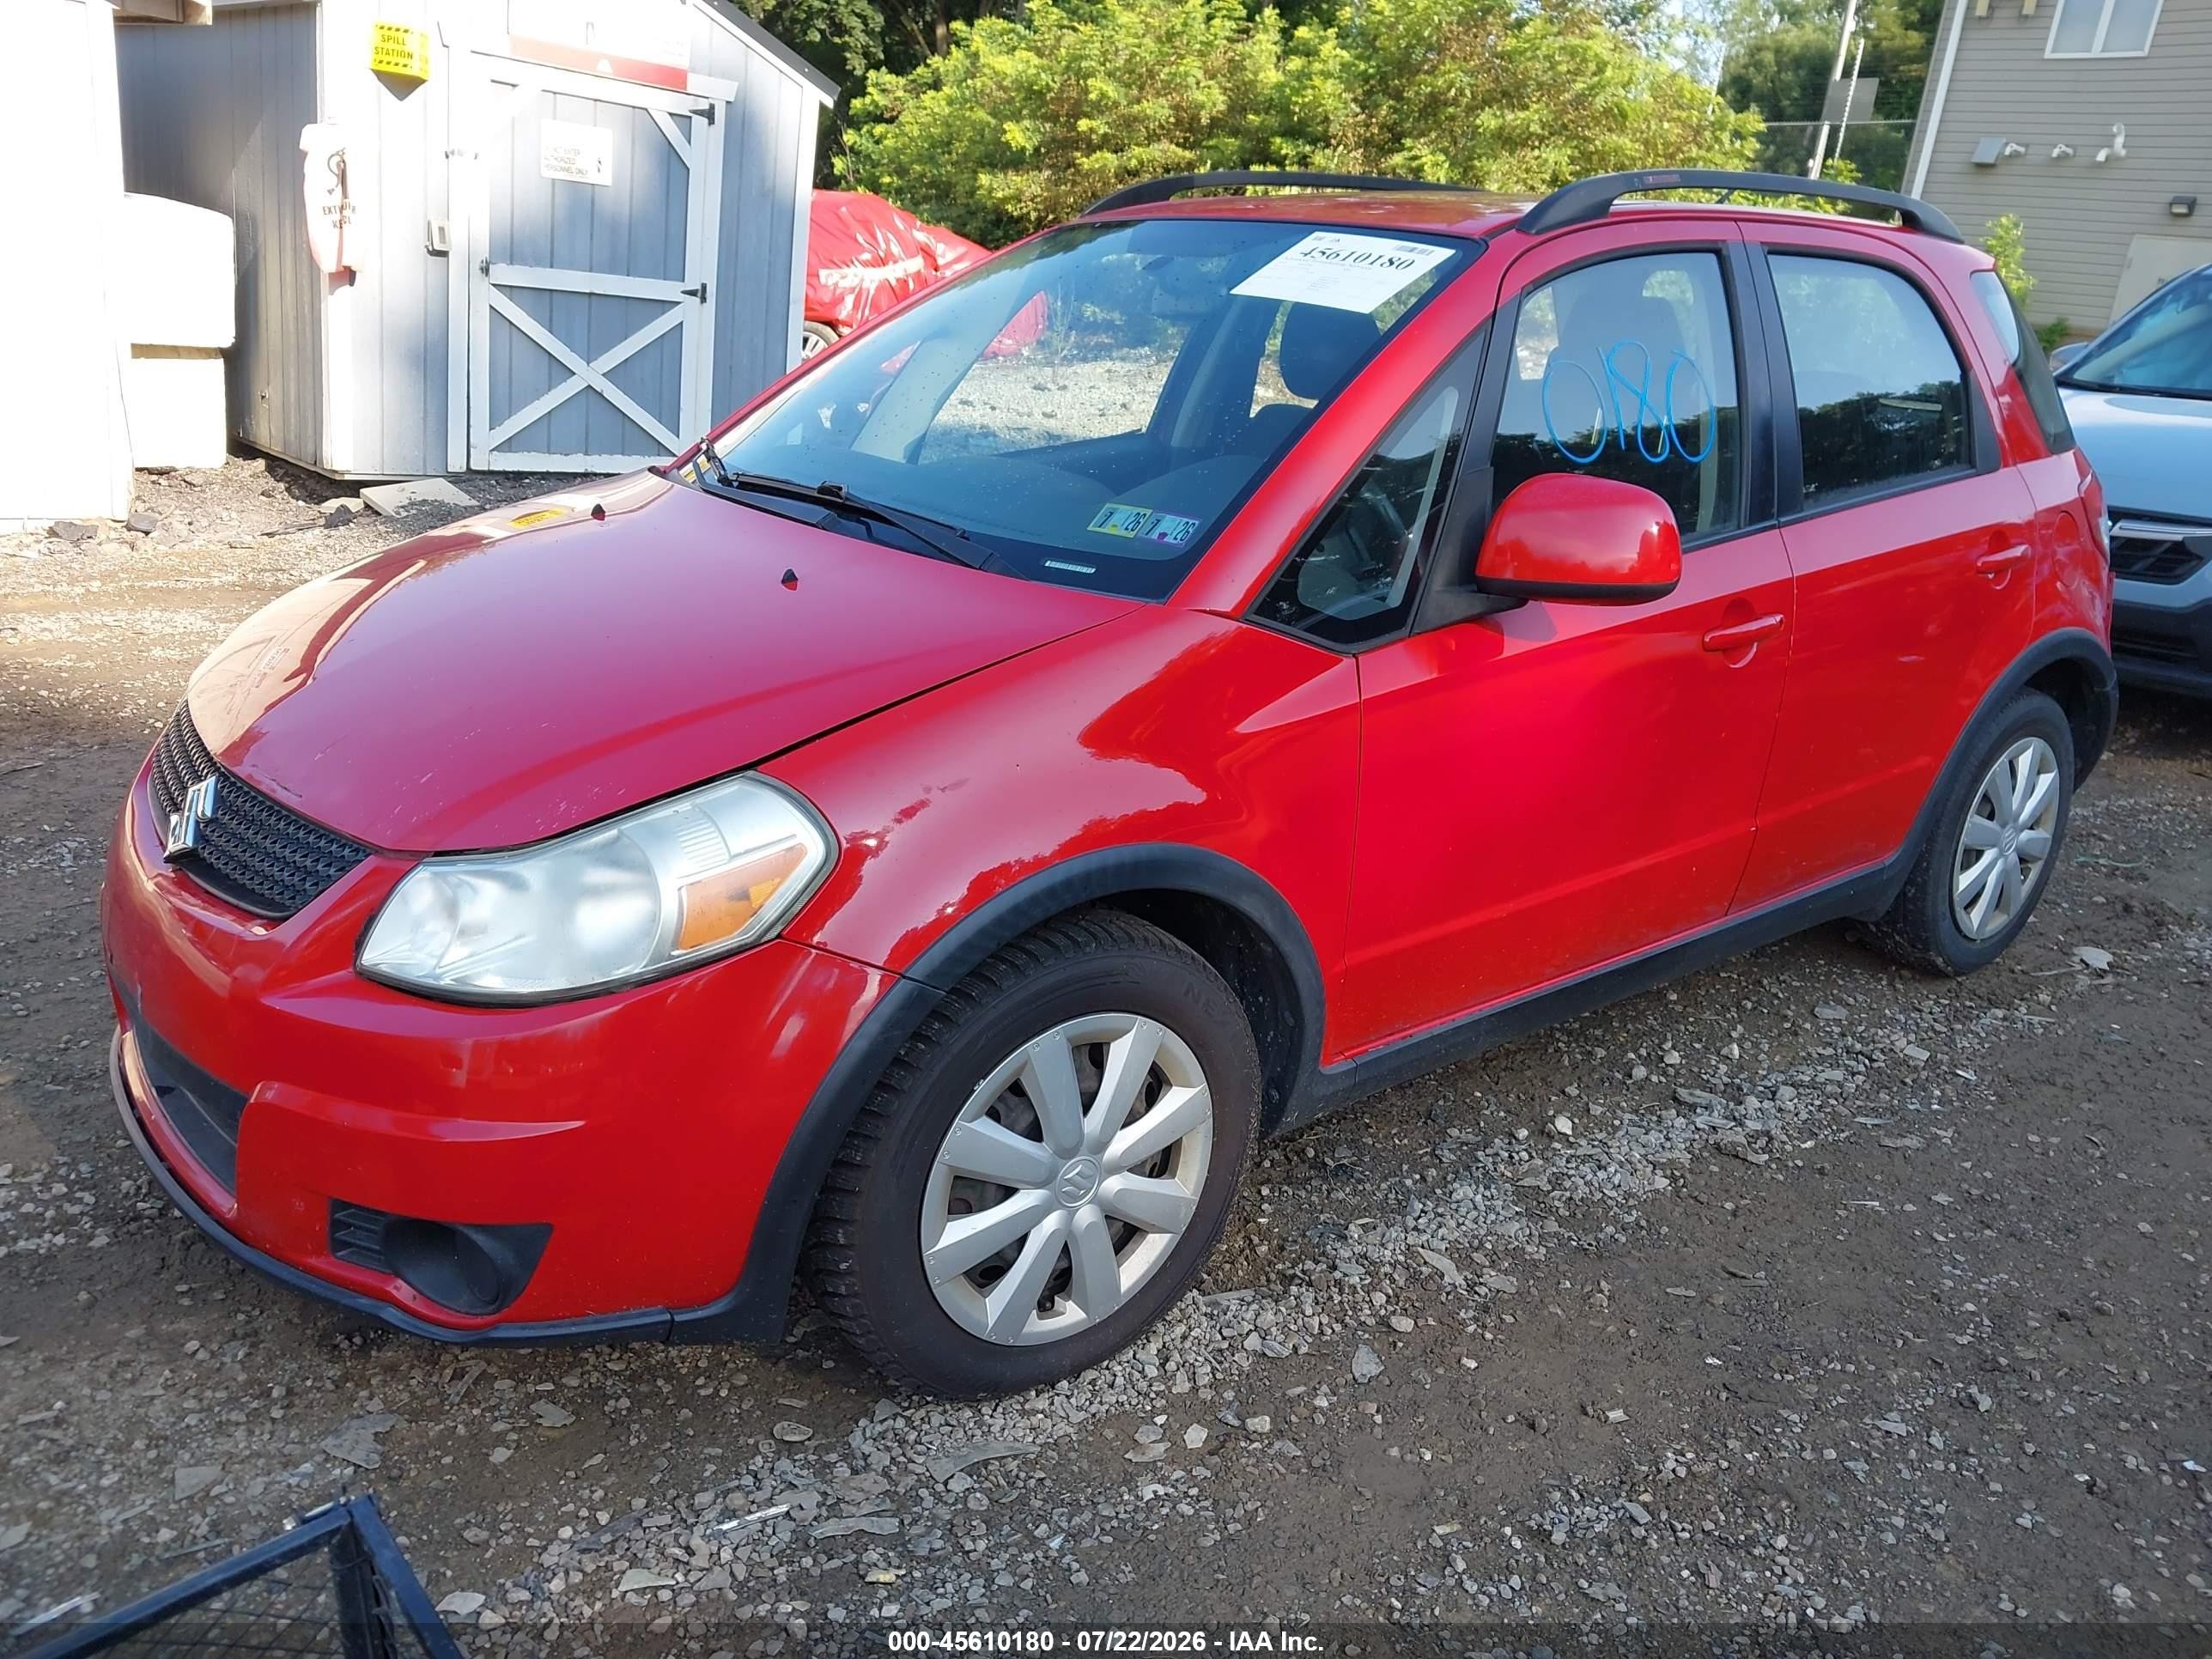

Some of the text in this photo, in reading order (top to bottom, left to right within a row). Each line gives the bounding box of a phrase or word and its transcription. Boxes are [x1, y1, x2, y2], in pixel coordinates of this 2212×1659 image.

[380, 33, 406, 46] SPILL
[374, 46, 413, 60] STATION
[1299, 246, 1416, 270] 45610180
[1541, 340, 1716, 464] 0180
[1124, 512, 1147, 532] 26
[1173, 520, 1196, 542] 26
